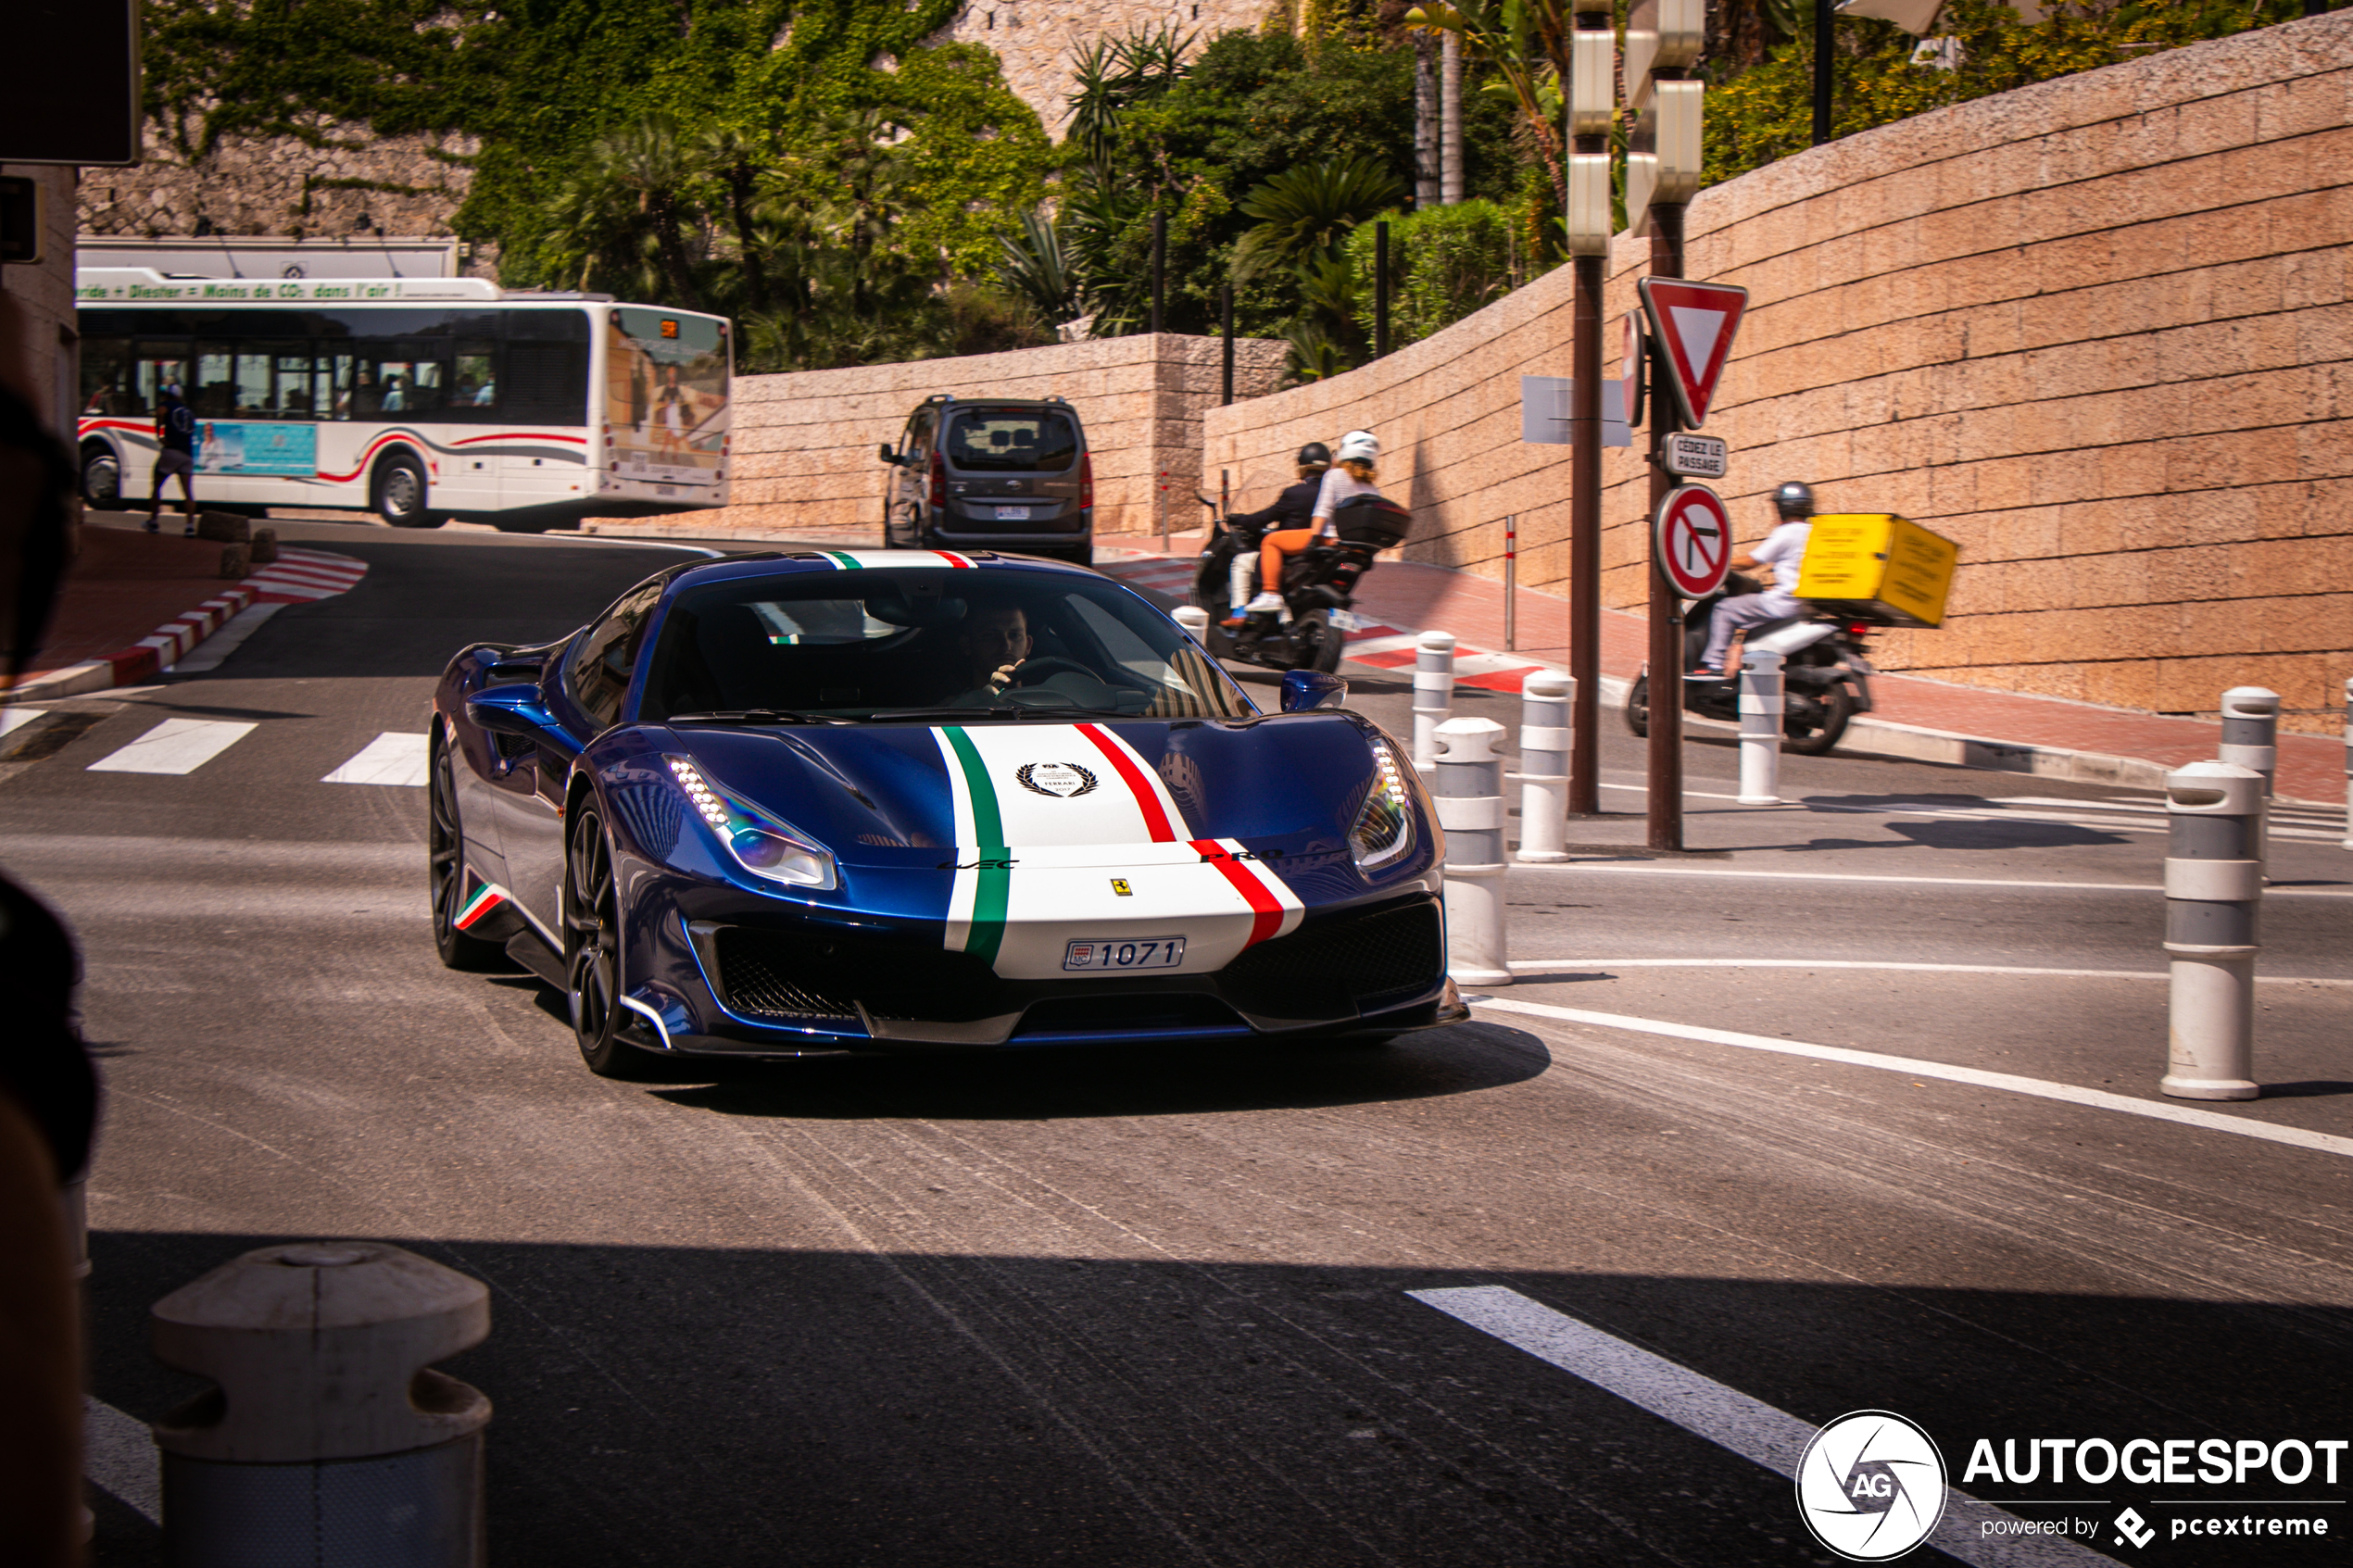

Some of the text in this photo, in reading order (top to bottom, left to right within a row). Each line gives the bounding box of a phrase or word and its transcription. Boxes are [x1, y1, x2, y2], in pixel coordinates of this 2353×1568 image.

[130, 284, 182, 298] Diester
[187, 287, 197, 295] =
[202, 284, 247, 298] Moins
[253, 284, 272, 298] de
[313, 283, 350, 298] dans
[355, 283, 390, 298] l'air
[395, 283, 403, 298] !
[1678, 438, 1722, 457] CÉDEZ LE
[1678, 456, 1720, 471] PASSAGE
[1200, 849, 1284, 863] PRO
[1074, 942, 1176, 966] MC 1071
